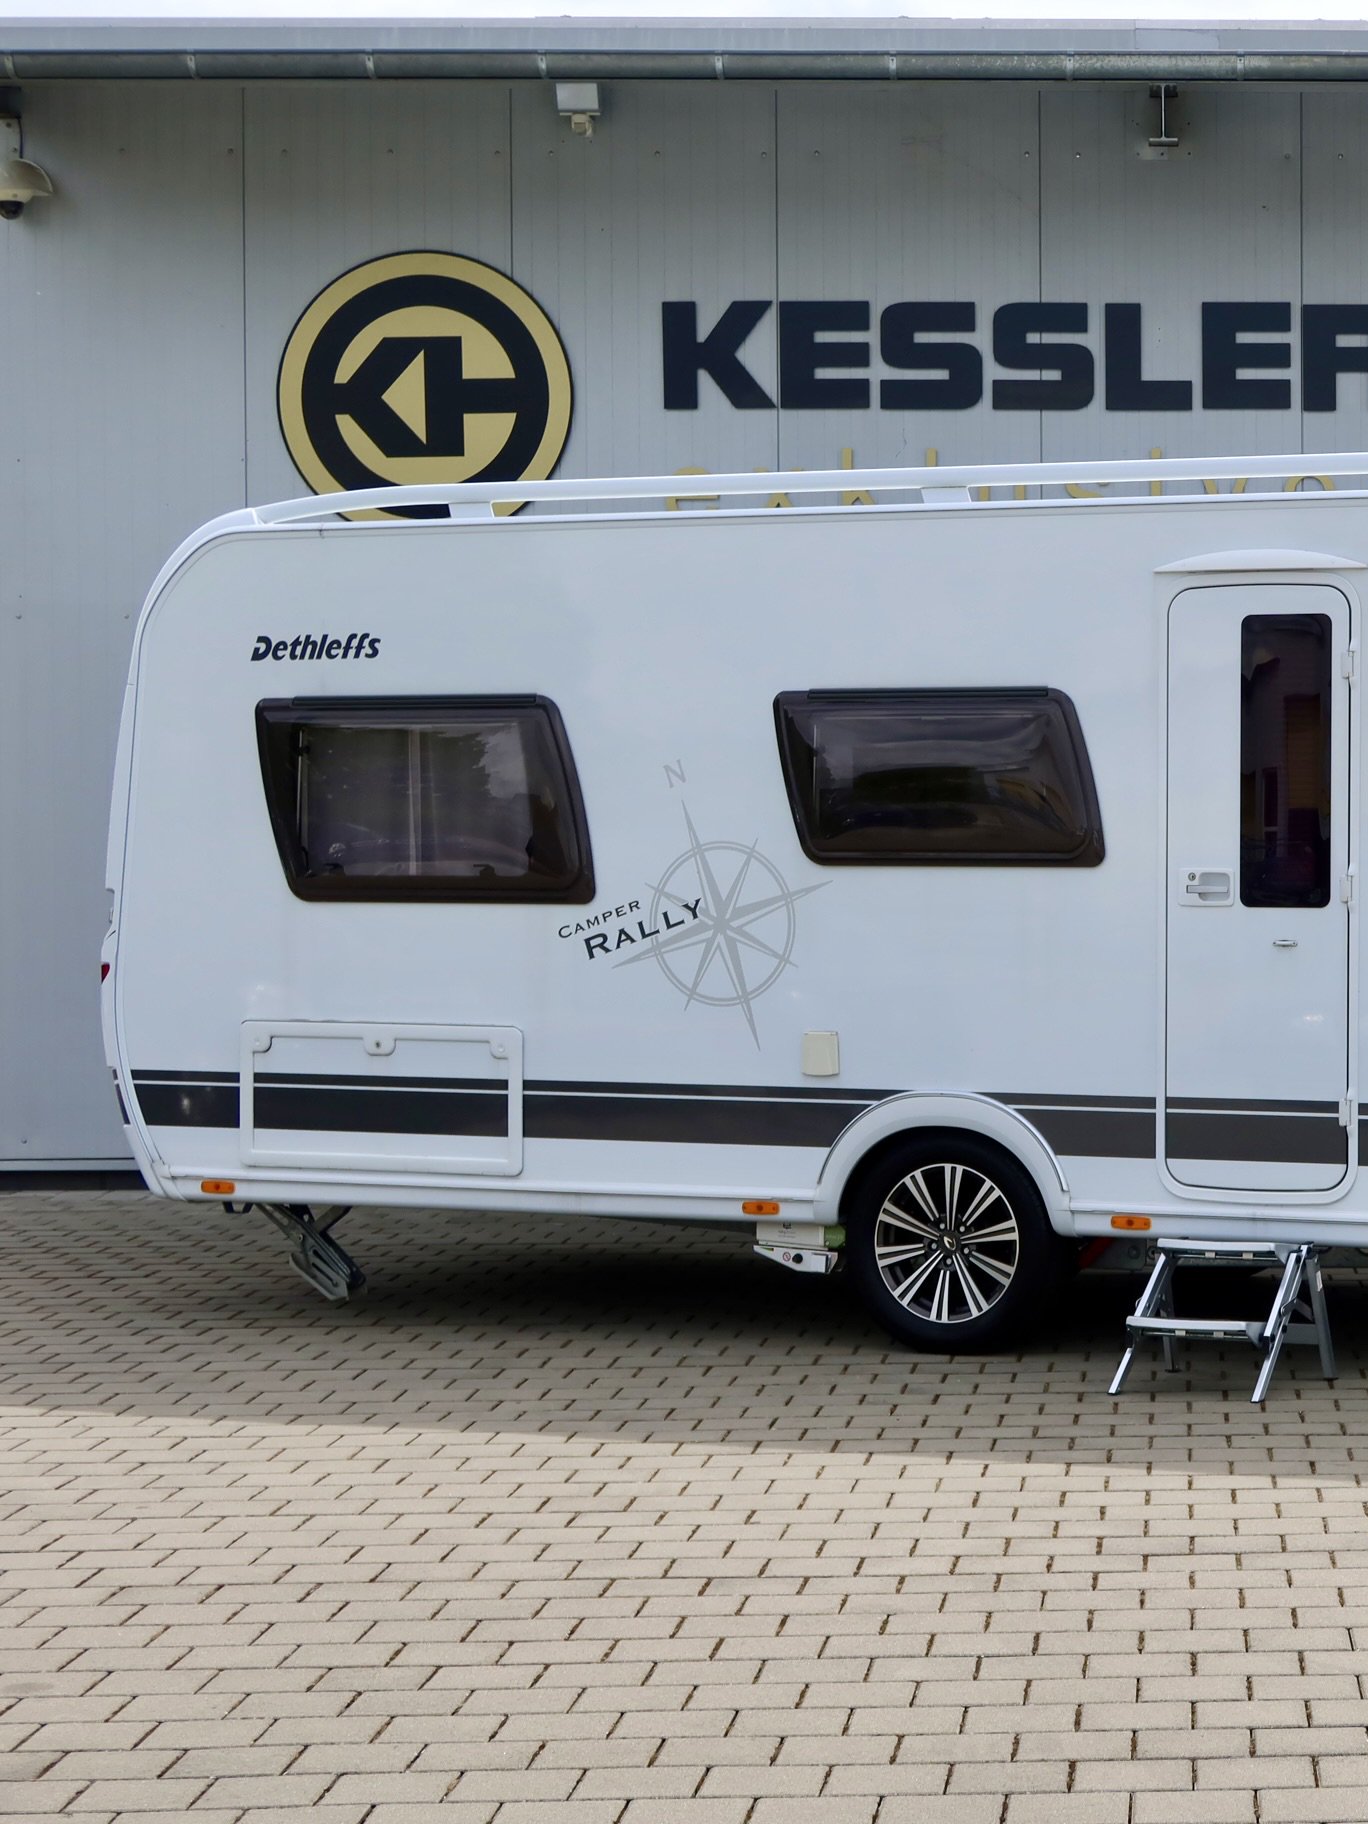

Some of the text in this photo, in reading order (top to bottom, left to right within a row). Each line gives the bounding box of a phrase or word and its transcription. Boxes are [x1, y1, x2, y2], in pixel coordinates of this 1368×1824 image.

[250, 632, 381, 661] Dethleffs
[663, 759, 687, 789] N
[558, 900, 641, 938] CAMPER
[583, 898, 702, 960] RALLY
